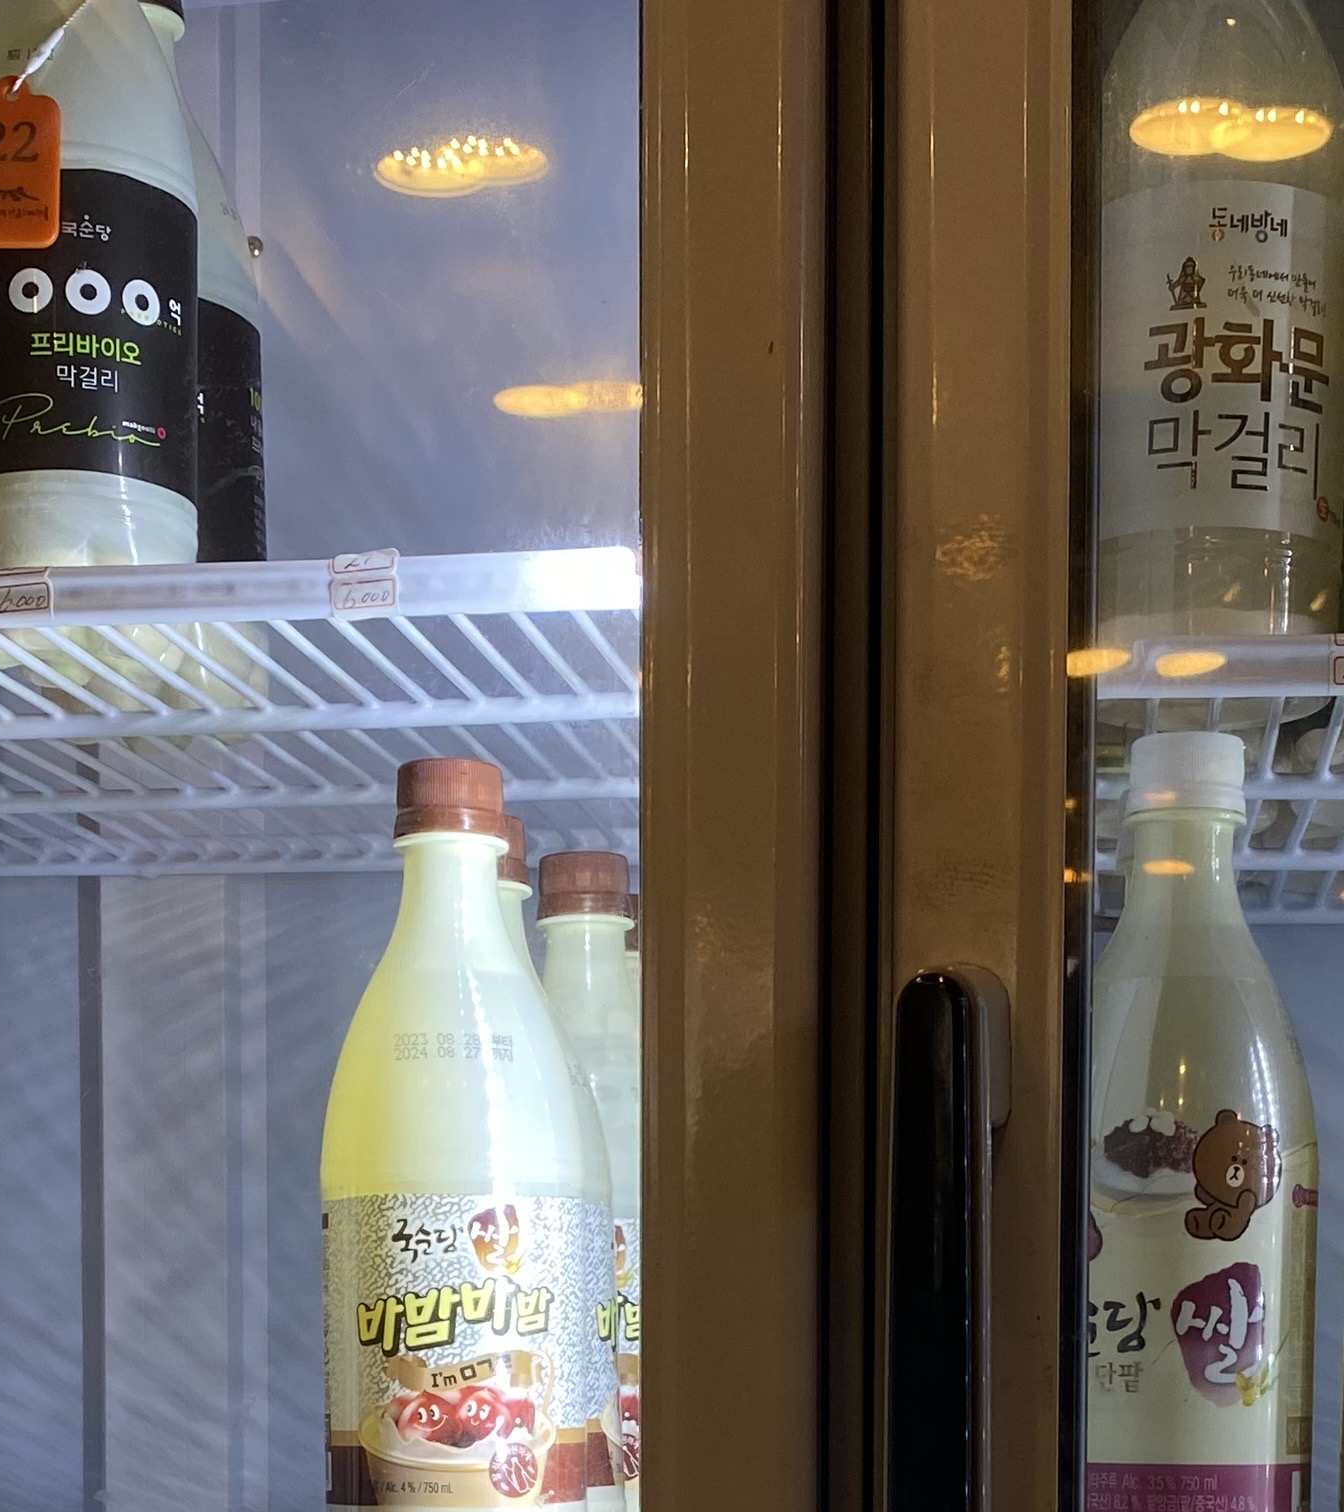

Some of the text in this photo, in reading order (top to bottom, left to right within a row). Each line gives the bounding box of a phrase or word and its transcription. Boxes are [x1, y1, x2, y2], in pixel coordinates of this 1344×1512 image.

[62, 215, 112, 242] 국순당
[1209, 206, 1289, 243] 동네방네
[29, 331, 142, 366] 프리바이오
[1142, 317, 1331, 415] 광화문
[56, 364, 120, 393] 막걸리
[1147, 409, 1320, 501] 막걸리
[391, 1217, 464, 1264] 국순당
[356, 1275, 554, 1357] 바밤바밤
[1174, 1277, 1266, 1386] 쌀
[430, 1372, 458, 1388] I'm
[423, 1481, 440, 1494] 750
